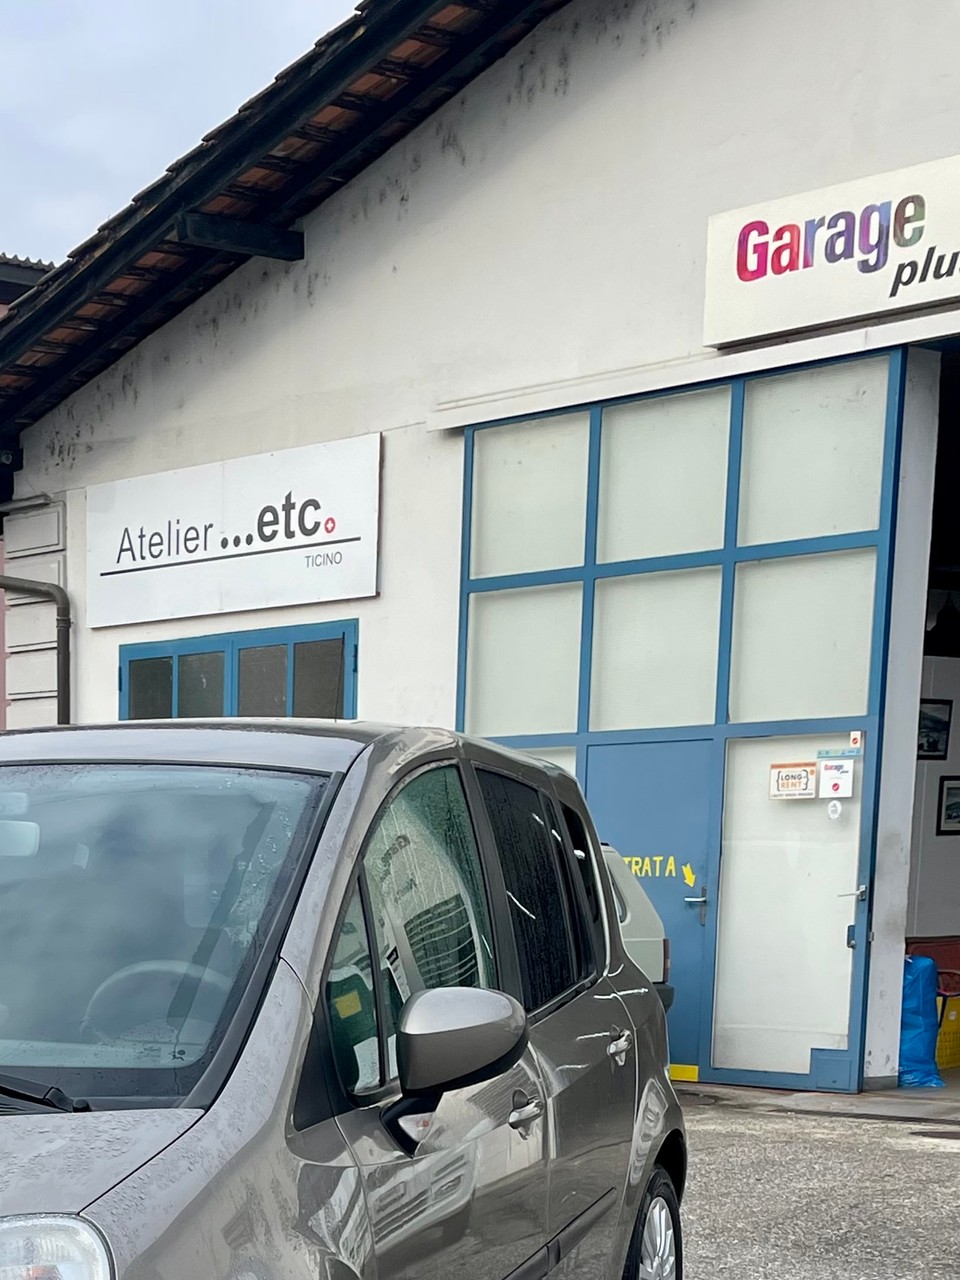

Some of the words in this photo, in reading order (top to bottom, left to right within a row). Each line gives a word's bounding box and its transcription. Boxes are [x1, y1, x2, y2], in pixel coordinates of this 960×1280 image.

[737, 194, 925, 282] Garage
[889, 245, 960, 298] plu
[117, 519, 214, 563] Atelier
[305, 551, 342, 568] TICINO
[781, 781, 802, 789] RENT
